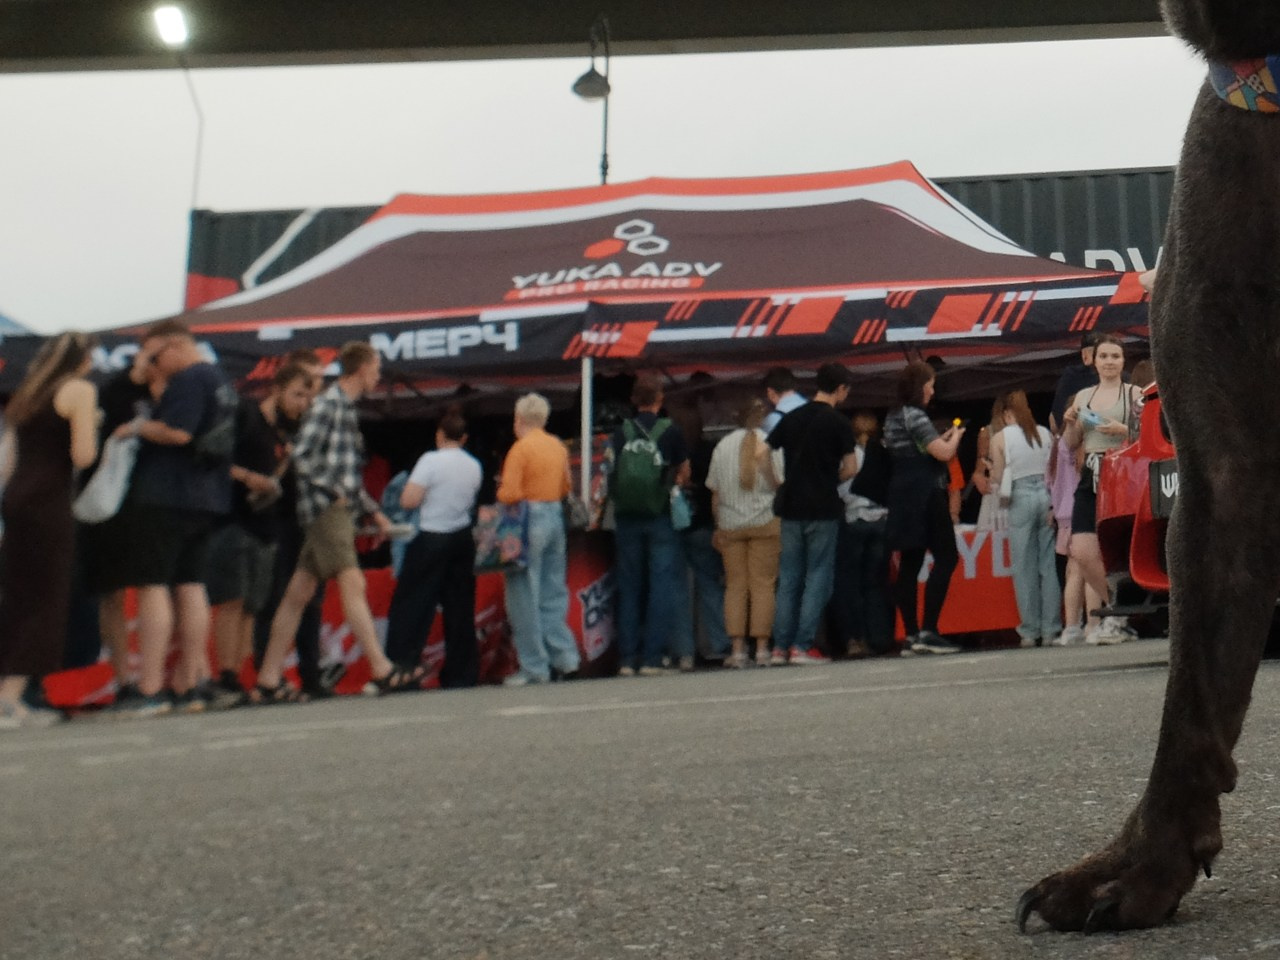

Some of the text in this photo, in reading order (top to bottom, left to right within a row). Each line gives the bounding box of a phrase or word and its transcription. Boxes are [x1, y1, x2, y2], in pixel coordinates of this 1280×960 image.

[512, 261, 723, 289] YUKA ADV
[582, 277, 692, 292] RACING
[370, 320, 518, 361] МЕРЧ
